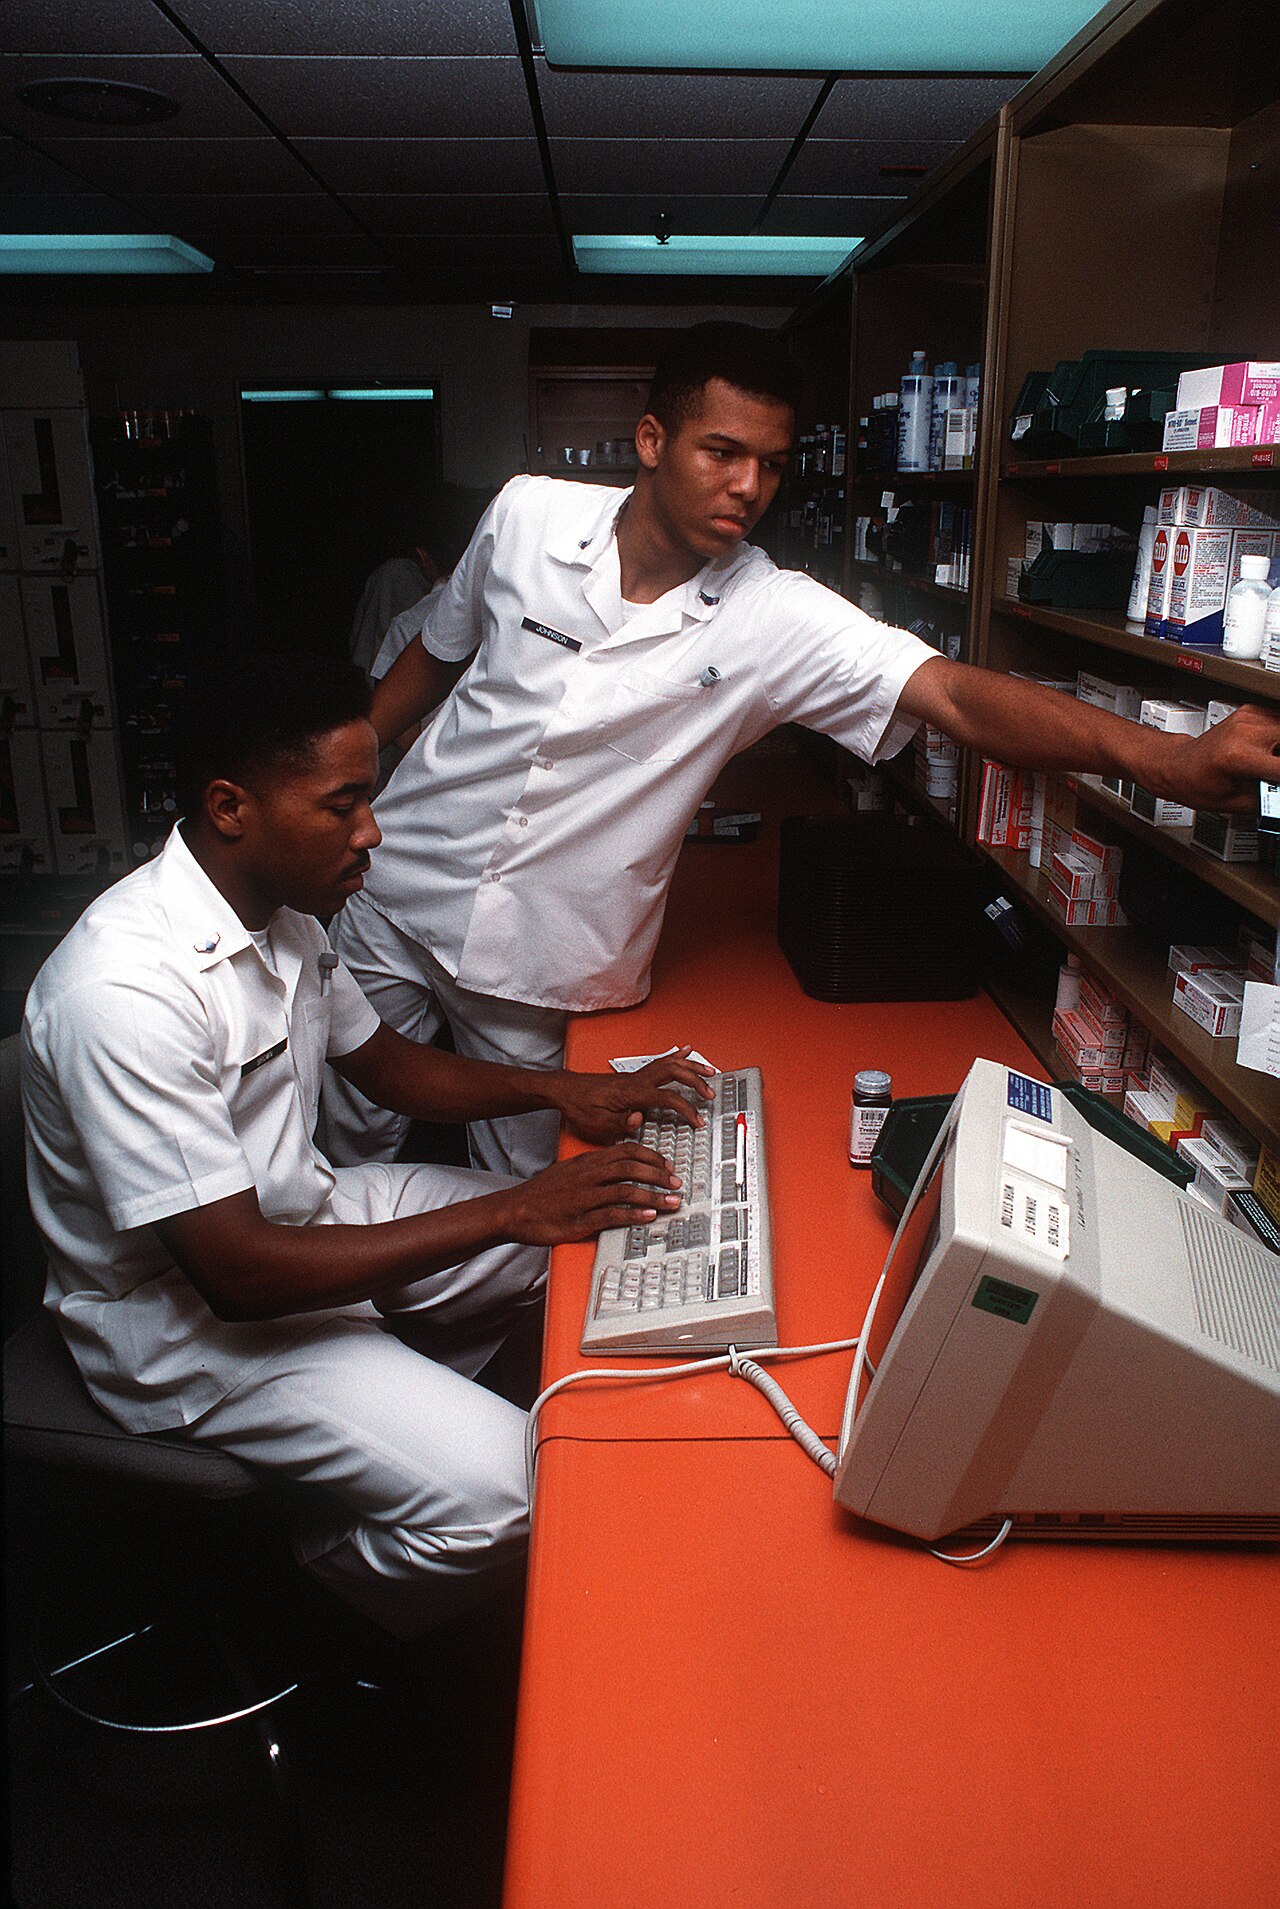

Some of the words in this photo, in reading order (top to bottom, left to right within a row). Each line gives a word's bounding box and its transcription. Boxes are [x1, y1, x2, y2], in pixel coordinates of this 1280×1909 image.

[1154, 542, 1167, 561] RID
[1174, 544, 1190, 564] RID
[535, 625, 569, 645] JOHNSON
[1002, 1183, 1015, 1202] WORK
[1000, 1200, 1013, 1228] STATION
[1024, 1196, 1037, 1225] DRINKING
[1047, 1204, 1059, 1215] NO
[1024, 1223, 1036, 1235] AT
[1047, 1214, 1059, 1236] EATING
